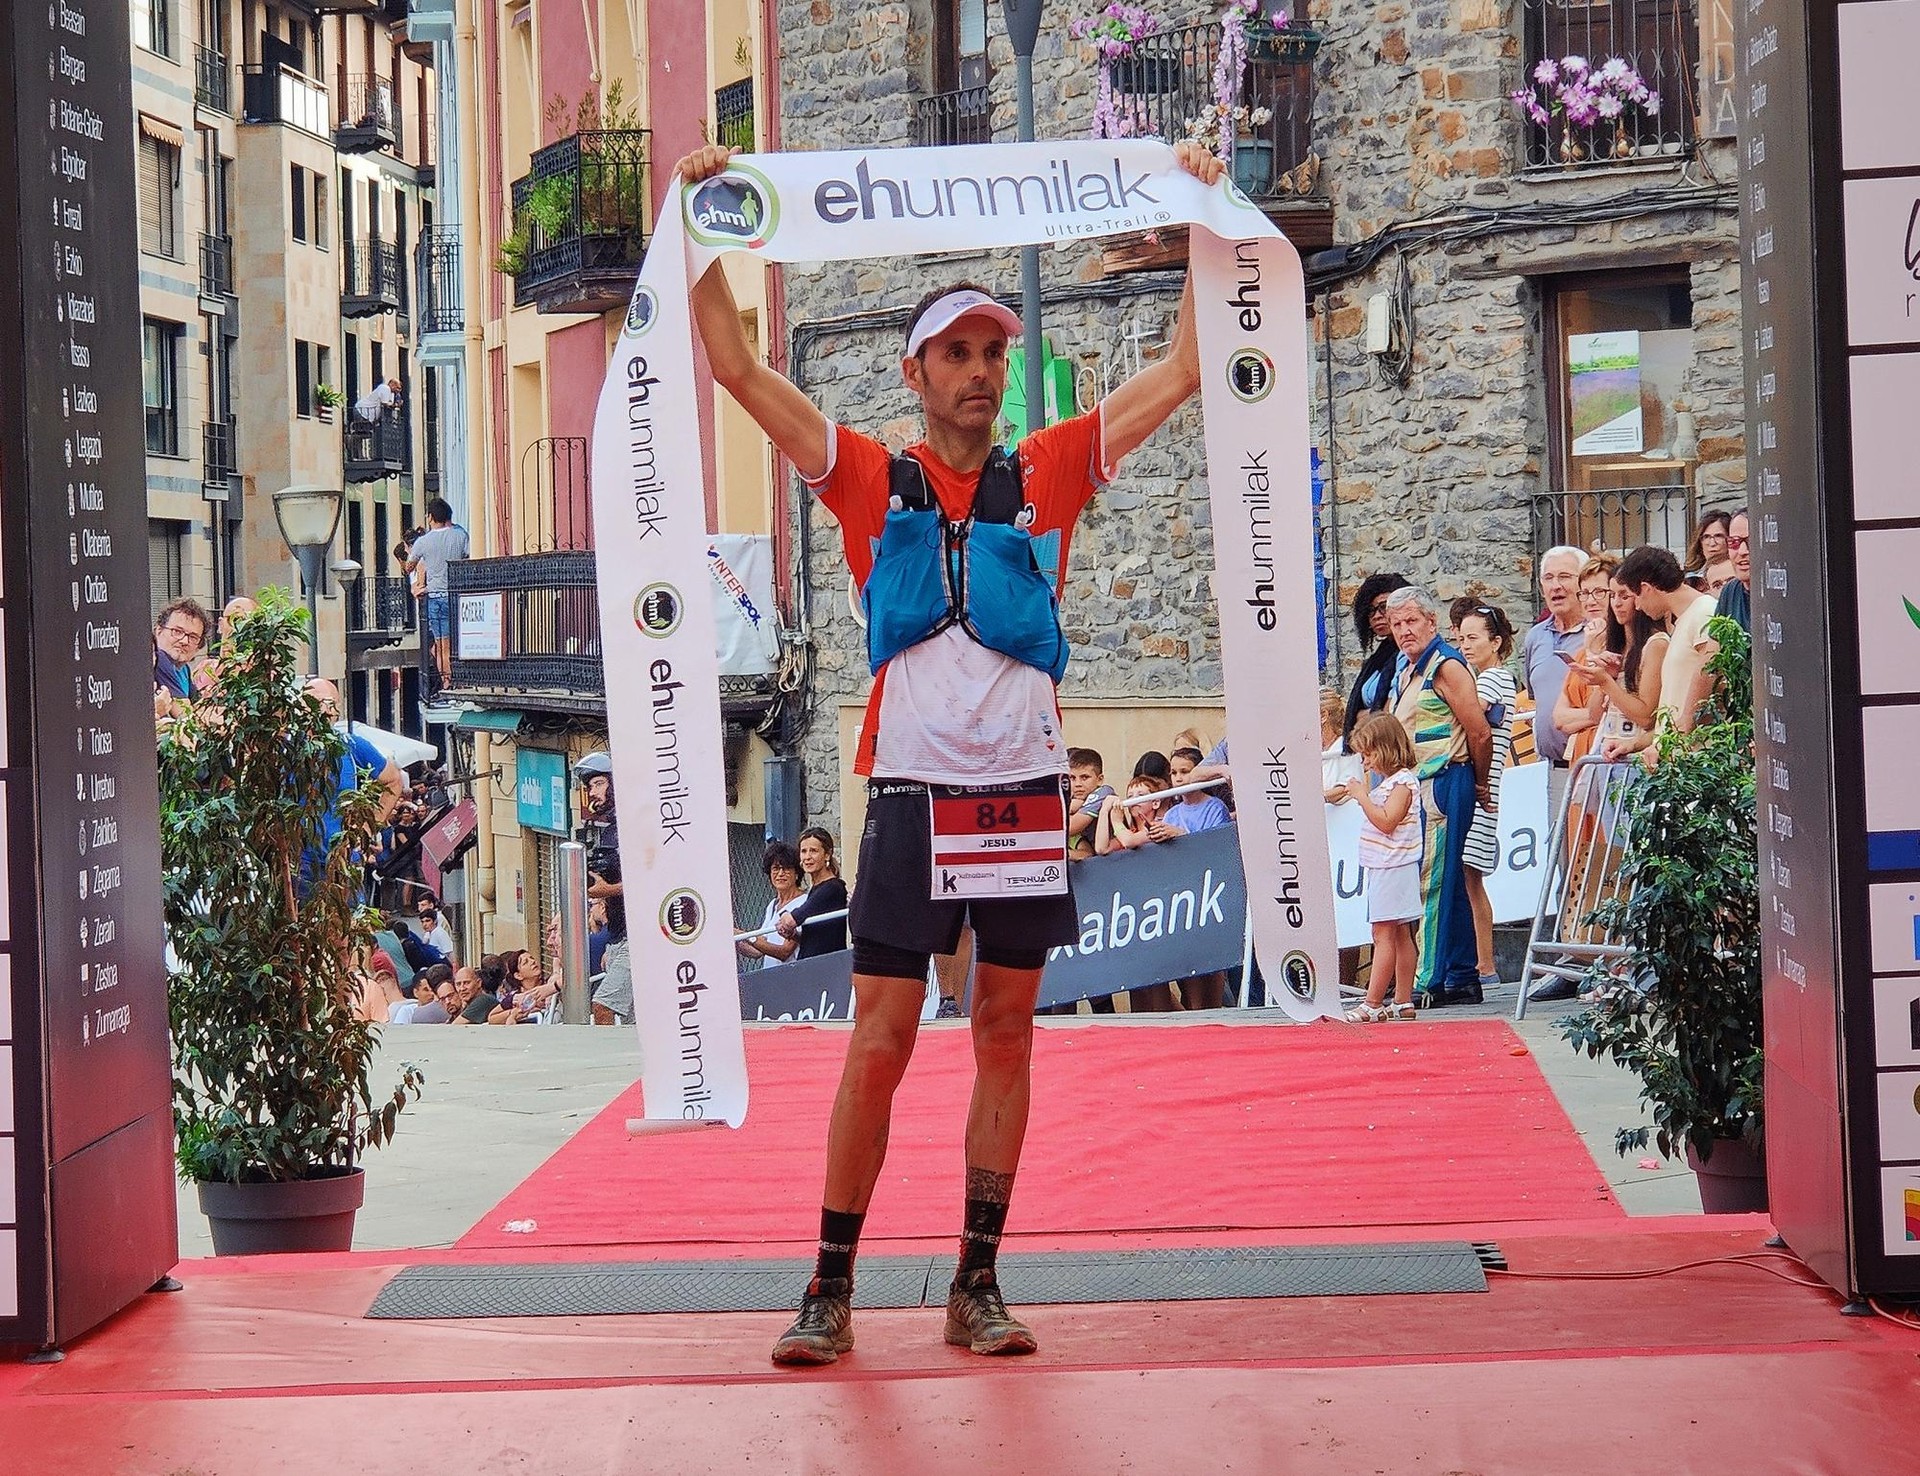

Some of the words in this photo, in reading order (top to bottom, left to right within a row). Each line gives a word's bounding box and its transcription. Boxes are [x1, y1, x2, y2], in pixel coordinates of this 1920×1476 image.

[60, 46, 86, 85] Bergara
[813, 156, 1161, 225] ehunmilak
[1045, 215, 1148, 237] Ultra-Trail
[626, 355, 668, 541] ehunmilak
[1240, 449, 1277, 631] ehunmilak
[88, 674, 113, 710] Segura
[89, 728, 113, 756] Tolosa
[650, 658, 692, 846] ehunmilak
[976, 801, 1020, 829] 84
[980, 838, 1017, 848] JESUS
[1262, 746, 1303, 929] ehunmilak
[93, 865, 121, 898] Zegama
[1004, 876, 1047, 886] TERNUA
[94, 914, 116, 947] Zerain
[94, 962, 119, 993] Zestoa
